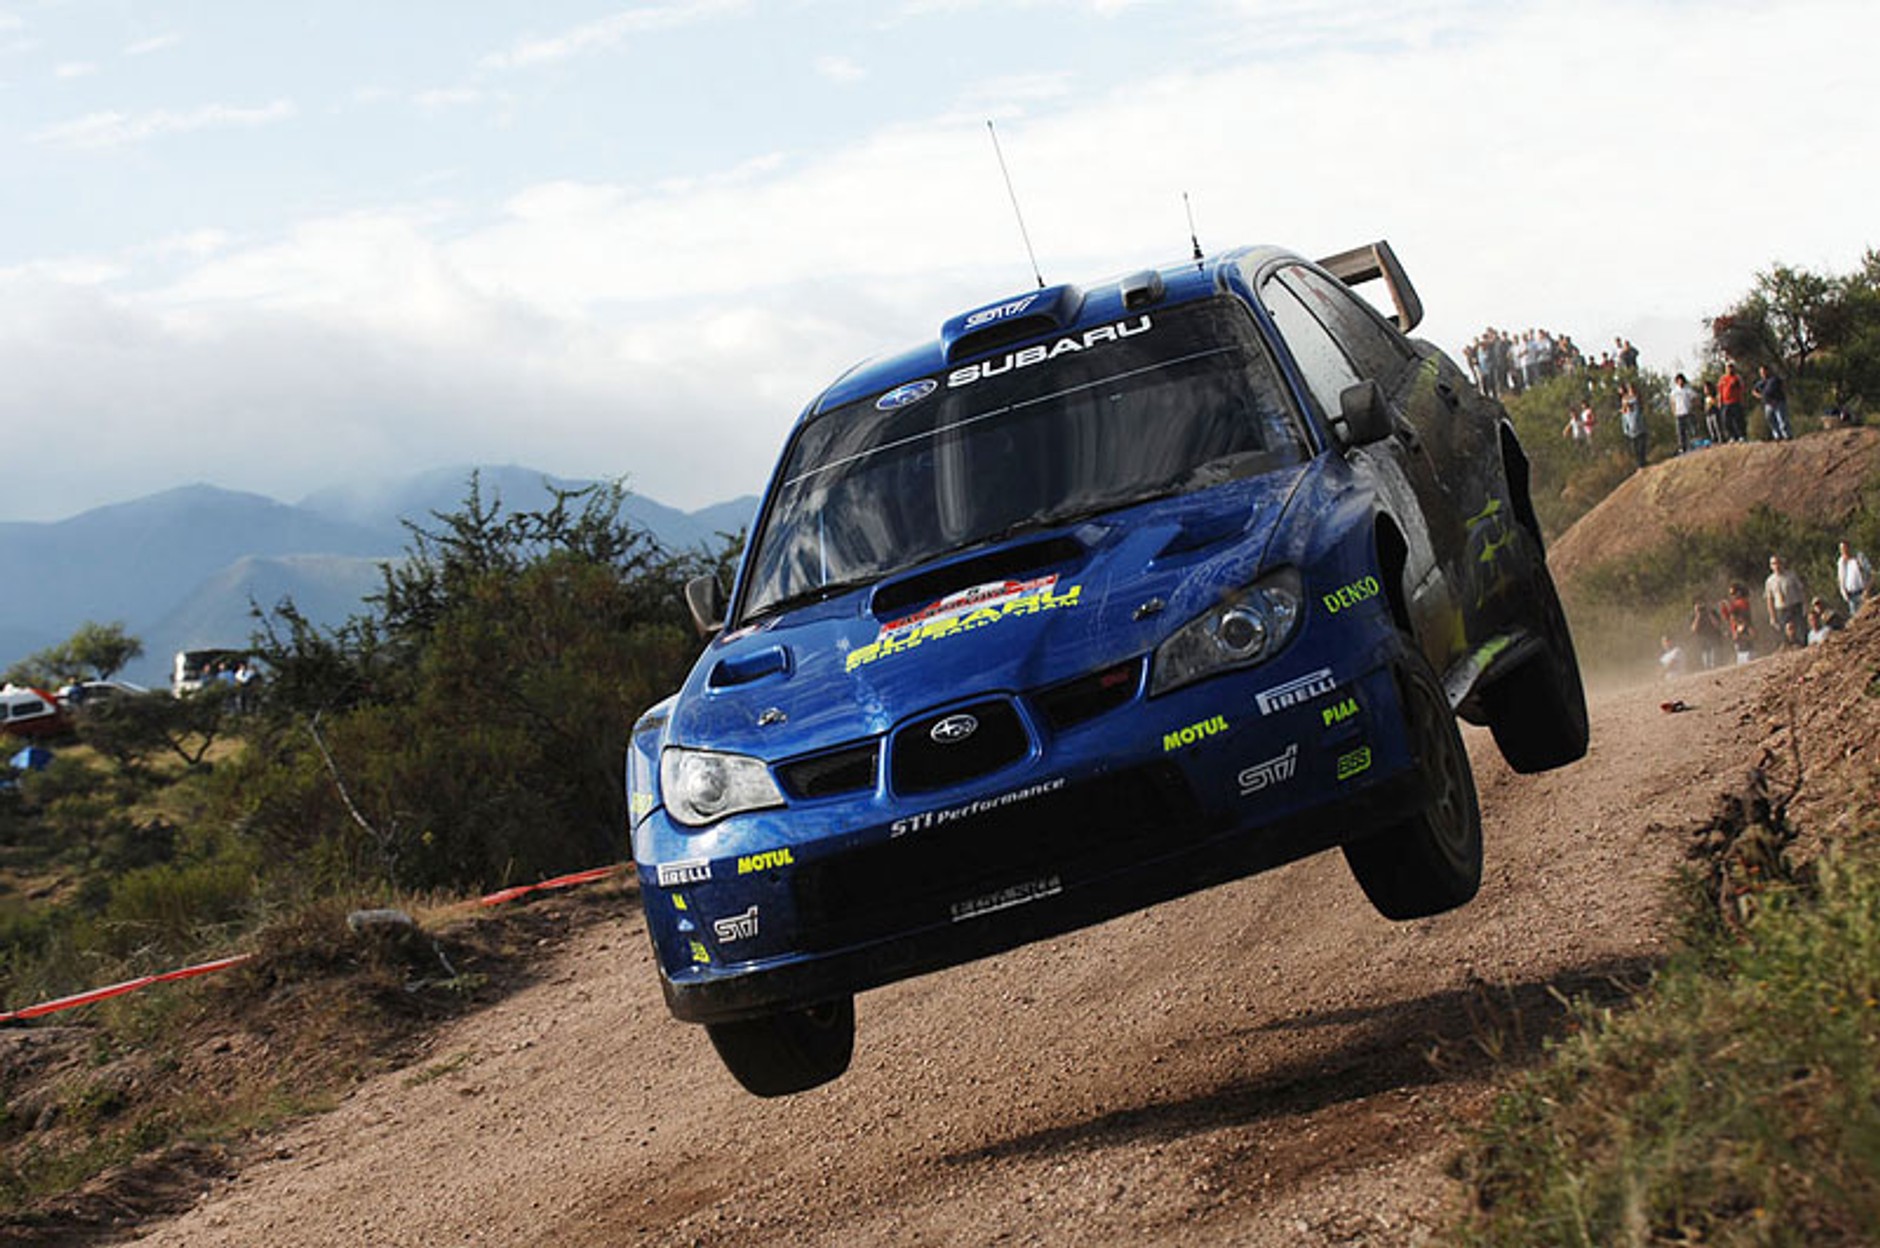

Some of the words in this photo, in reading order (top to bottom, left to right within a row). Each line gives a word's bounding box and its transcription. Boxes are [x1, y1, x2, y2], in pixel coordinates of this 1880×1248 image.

[948, 315, 1152, 387] SUBARU
[1323, 576, 1379, 613] DENSO
[846, 585, 1081, 662] SUBARU
[1255, 667, 1336, 716] PIRELLI
[1322, 698, 1360, 726] PIAA
[1163, 715, 1230, 752] MOTUL
[657, 858, 712, 887] PIRELLI
[737, 848, 794, 875] MOTUL
